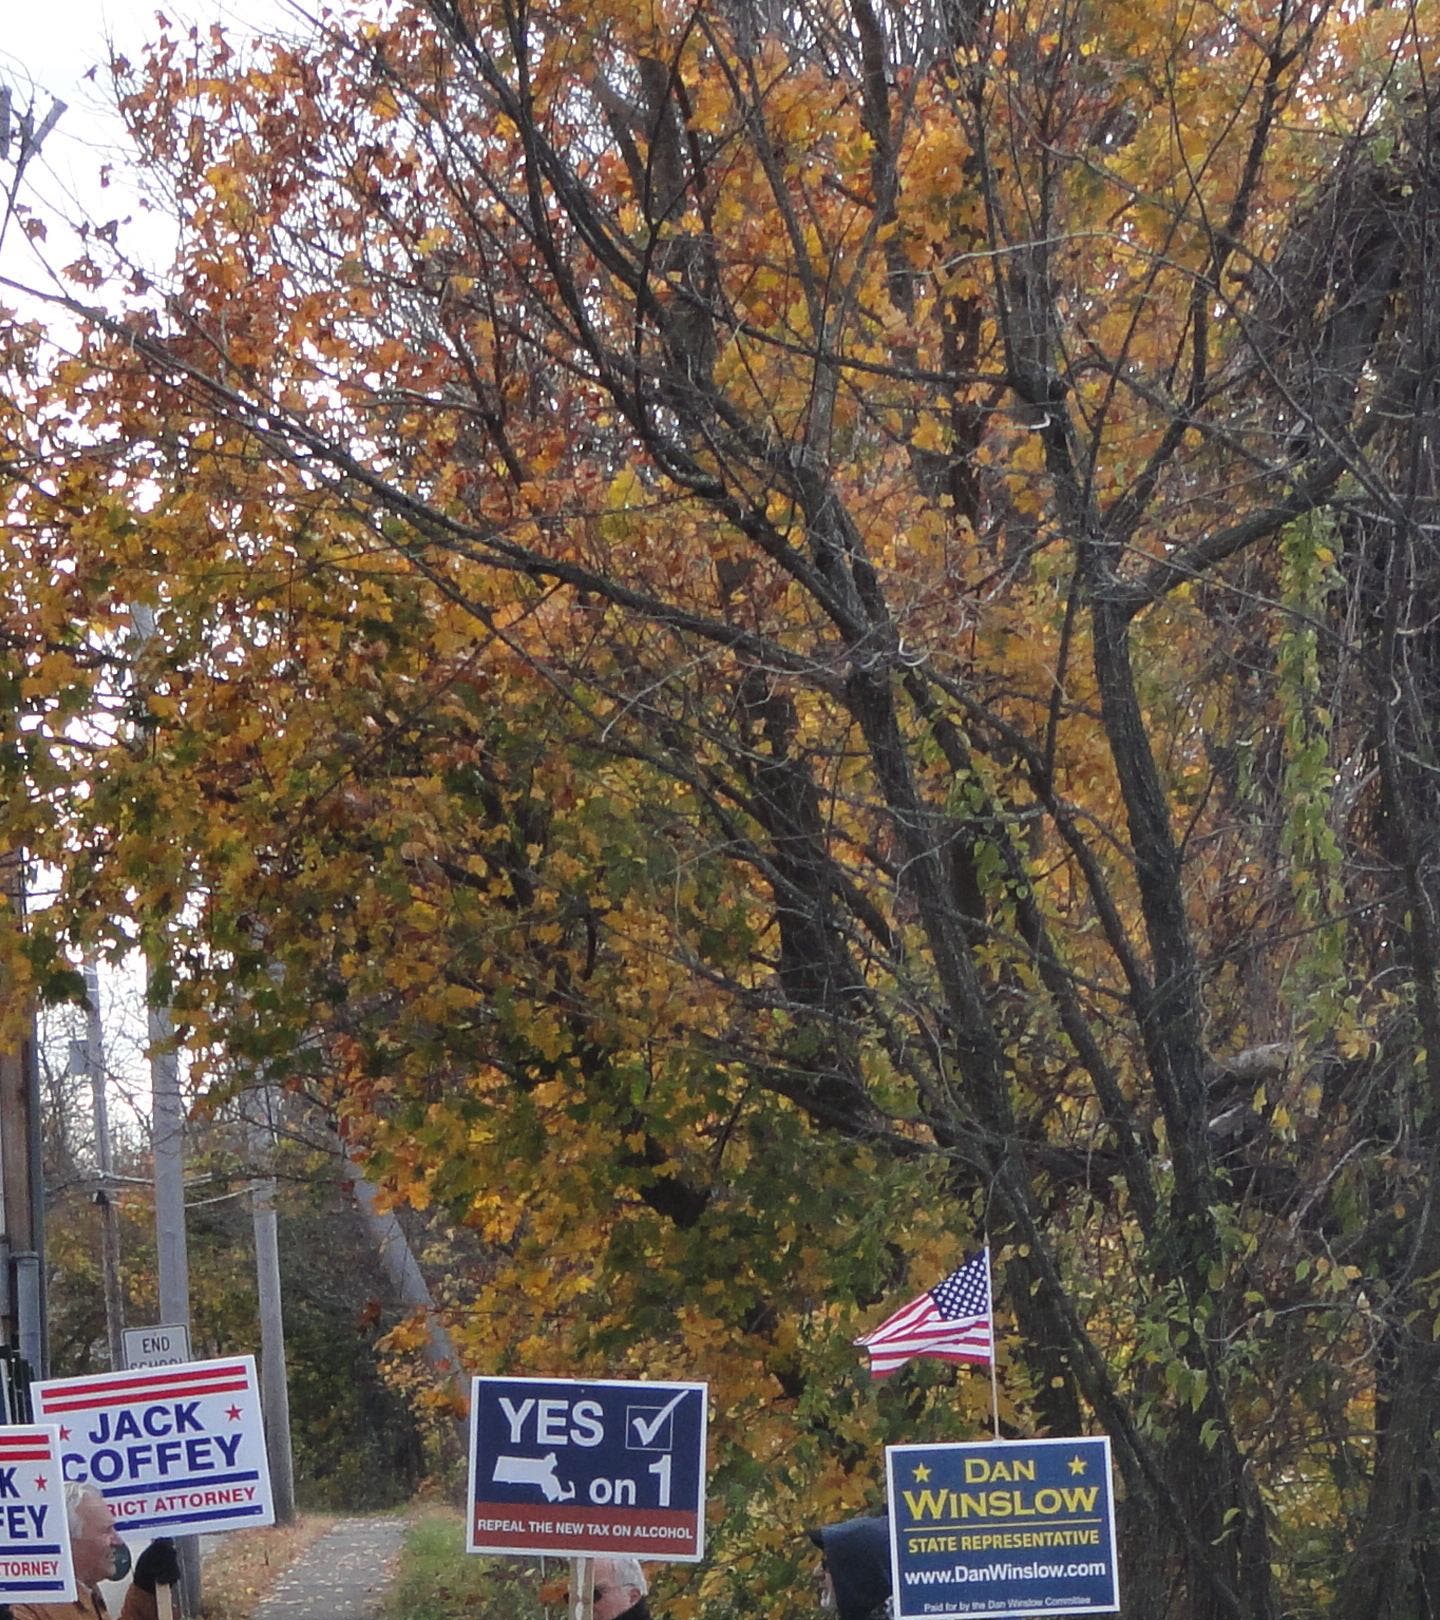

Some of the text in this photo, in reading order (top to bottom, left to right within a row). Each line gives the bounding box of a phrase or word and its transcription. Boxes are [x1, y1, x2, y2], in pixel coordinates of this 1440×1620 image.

[142, 1336, 170, 1353] END
[88, 1401, 205, 1445] JACK
[498, 1397, 604, 1447] YES
[62, 1433, 243, 1484] COFFEY
[964, 1458, 1036, 1484] DAN
[589, 1454, 672, 1507] on 1
[108, 1486, 256, 1517] RICT ATTORNEY
[902, 1487, 1099, 1521] WINSLOW
[477, 1519, 693, 1540] REPEAL THE NEW TAX ON ALCOHOL
[908, 1529, 1100, 1554] STATE REPRESENTATIVE
[904, 1561, 1106, 1586] www.DanWinslow.com
[924, 1602, 943, 1613] Paid
[945, 1602, 958, 1612] for
[959, 1601, 969, 1612] by
[972, 1600, 986, 1610] the
[988, 1600, 1006, 1609] Dan
